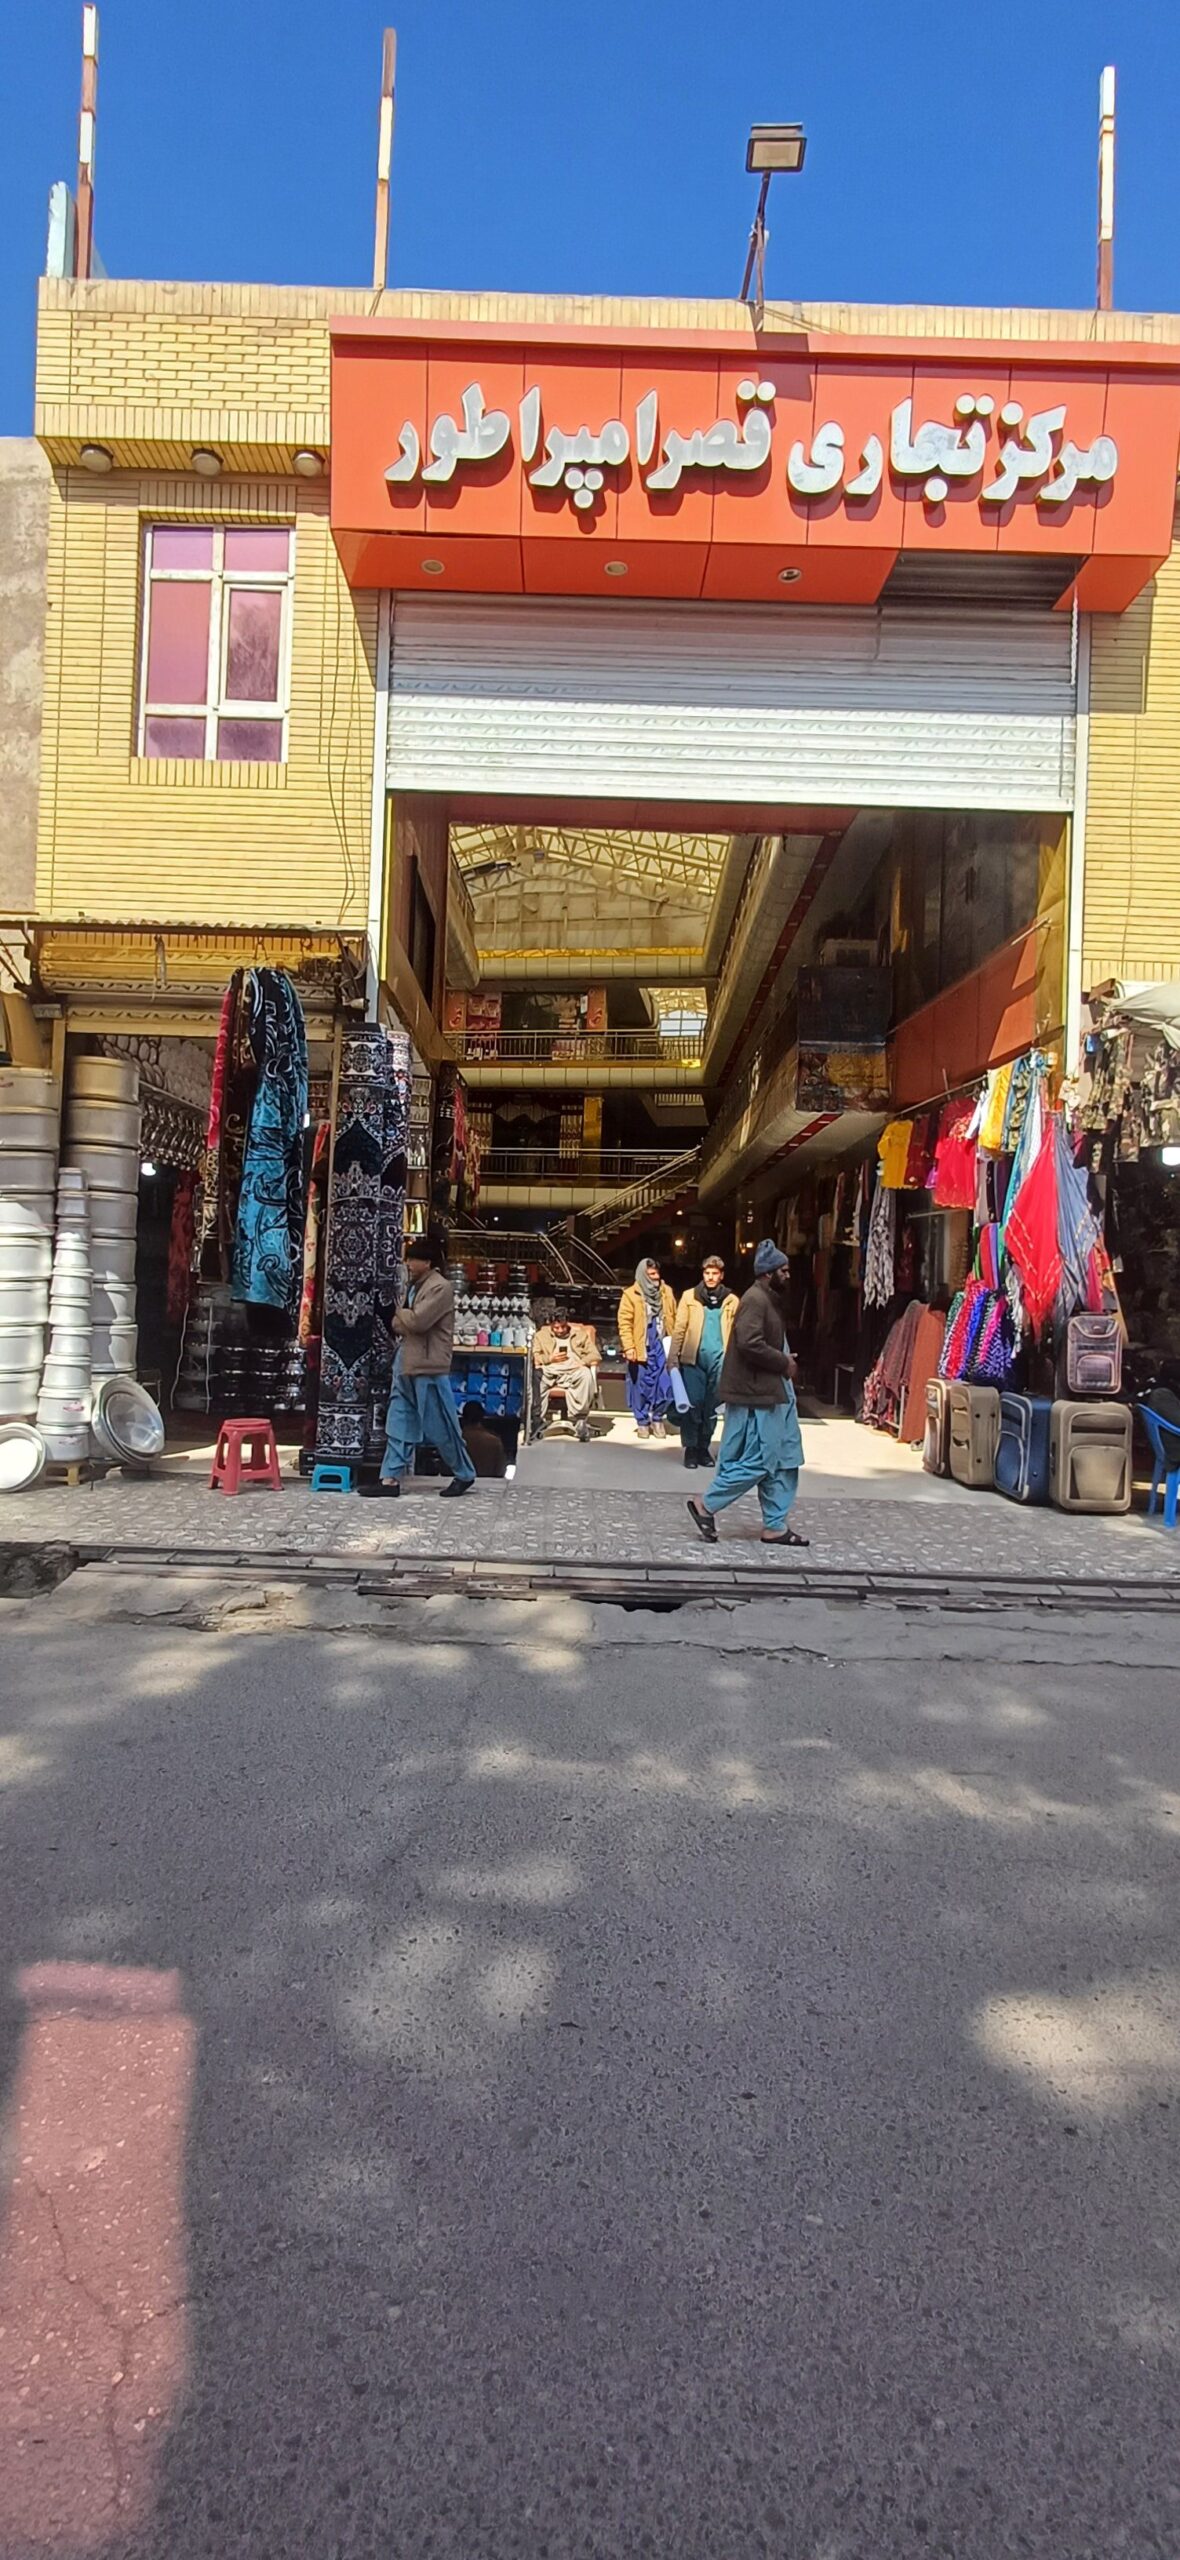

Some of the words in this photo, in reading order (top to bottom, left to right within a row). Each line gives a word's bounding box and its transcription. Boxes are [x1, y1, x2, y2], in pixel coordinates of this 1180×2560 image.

[384, 381, 657, 509] امپراطور
[645, 379, 777, 490] قصر
[787, 393, 995, 502] تجاری
[982, 401, 1118, 501] مرکز
